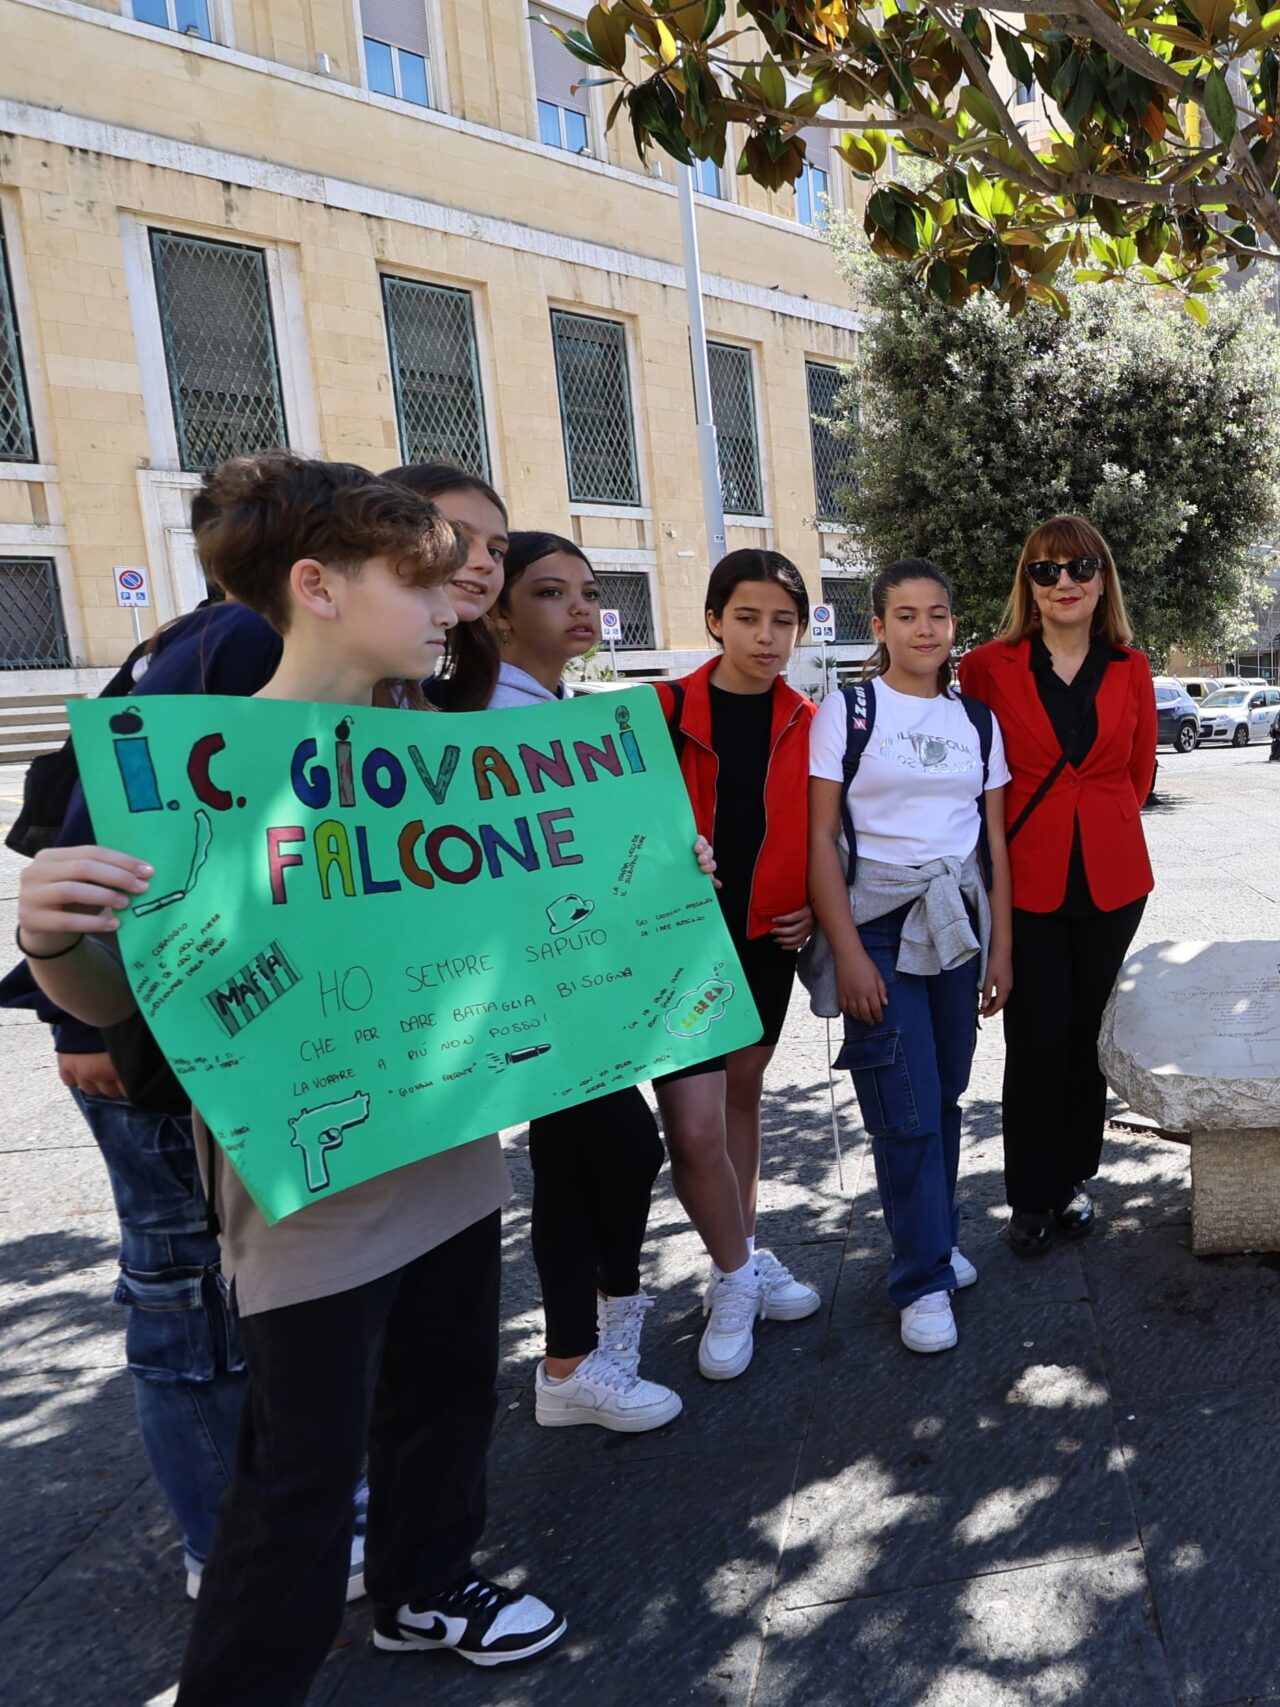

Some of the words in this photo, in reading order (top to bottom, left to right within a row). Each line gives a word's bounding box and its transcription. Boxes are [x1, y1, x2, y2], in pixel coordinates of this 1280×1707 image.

[267, 807, 583, 904] FALCONE
[300, 1038, 336, 1062] CHE
[355, 1027, 379, 1044] PER
[400, 1013, 437, 1032] DARE
[453, 995, 536, 1022] BATTAGLIA
[556, 967, 633, 998] BISOGNA
[318, 966, 373, 1017] HO
[405, 954, 494, 993] SEMPRE
[526, 929, 607, 963] SAPUTO
[680, 986, 724, 1030] LIBERA
[377, 1059, 387, 1070] A
[440, 1034, 475, 1051] NON
